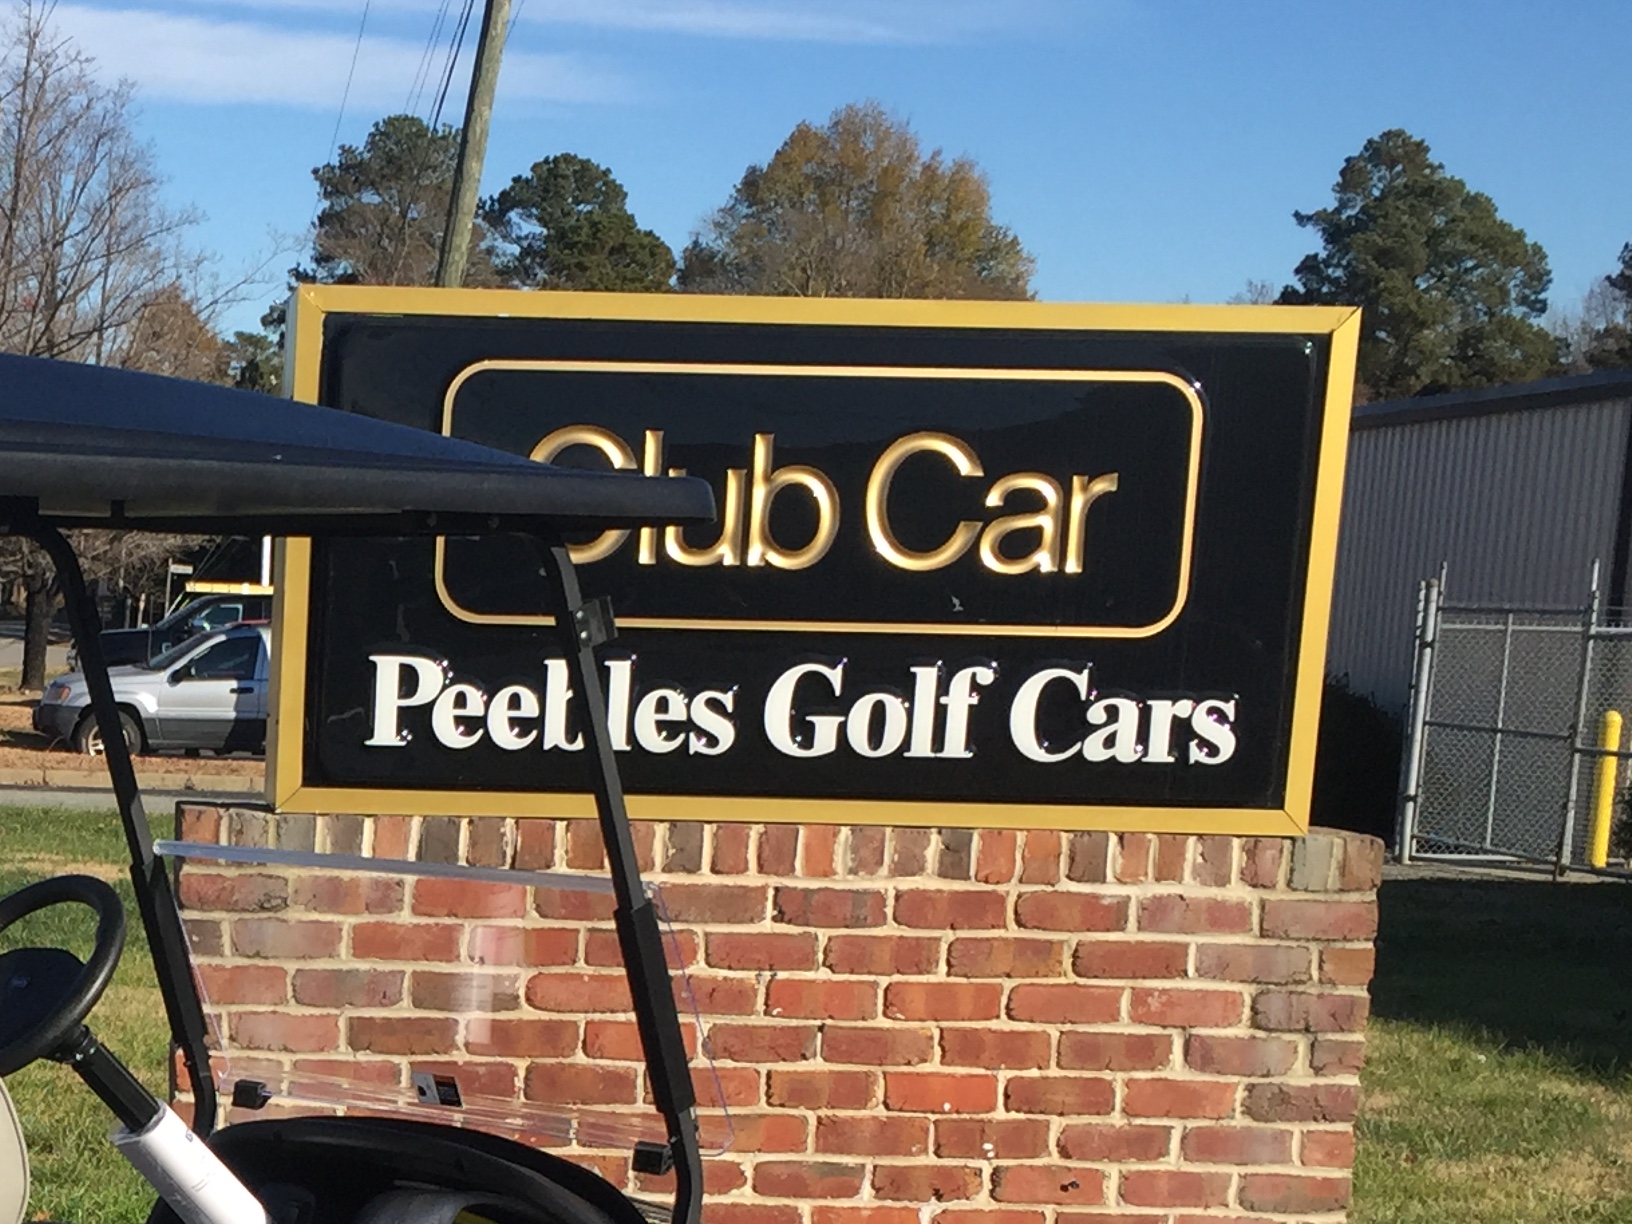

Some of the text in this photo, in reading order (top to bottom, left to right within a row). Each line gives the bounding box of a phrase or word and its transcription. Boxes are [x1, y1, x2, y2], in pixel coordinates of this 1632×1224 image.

[866, 430, 1119, 575] Car
[763, 661, 997, 759] Golf
[1009, 667, 1238, 765] Cars
